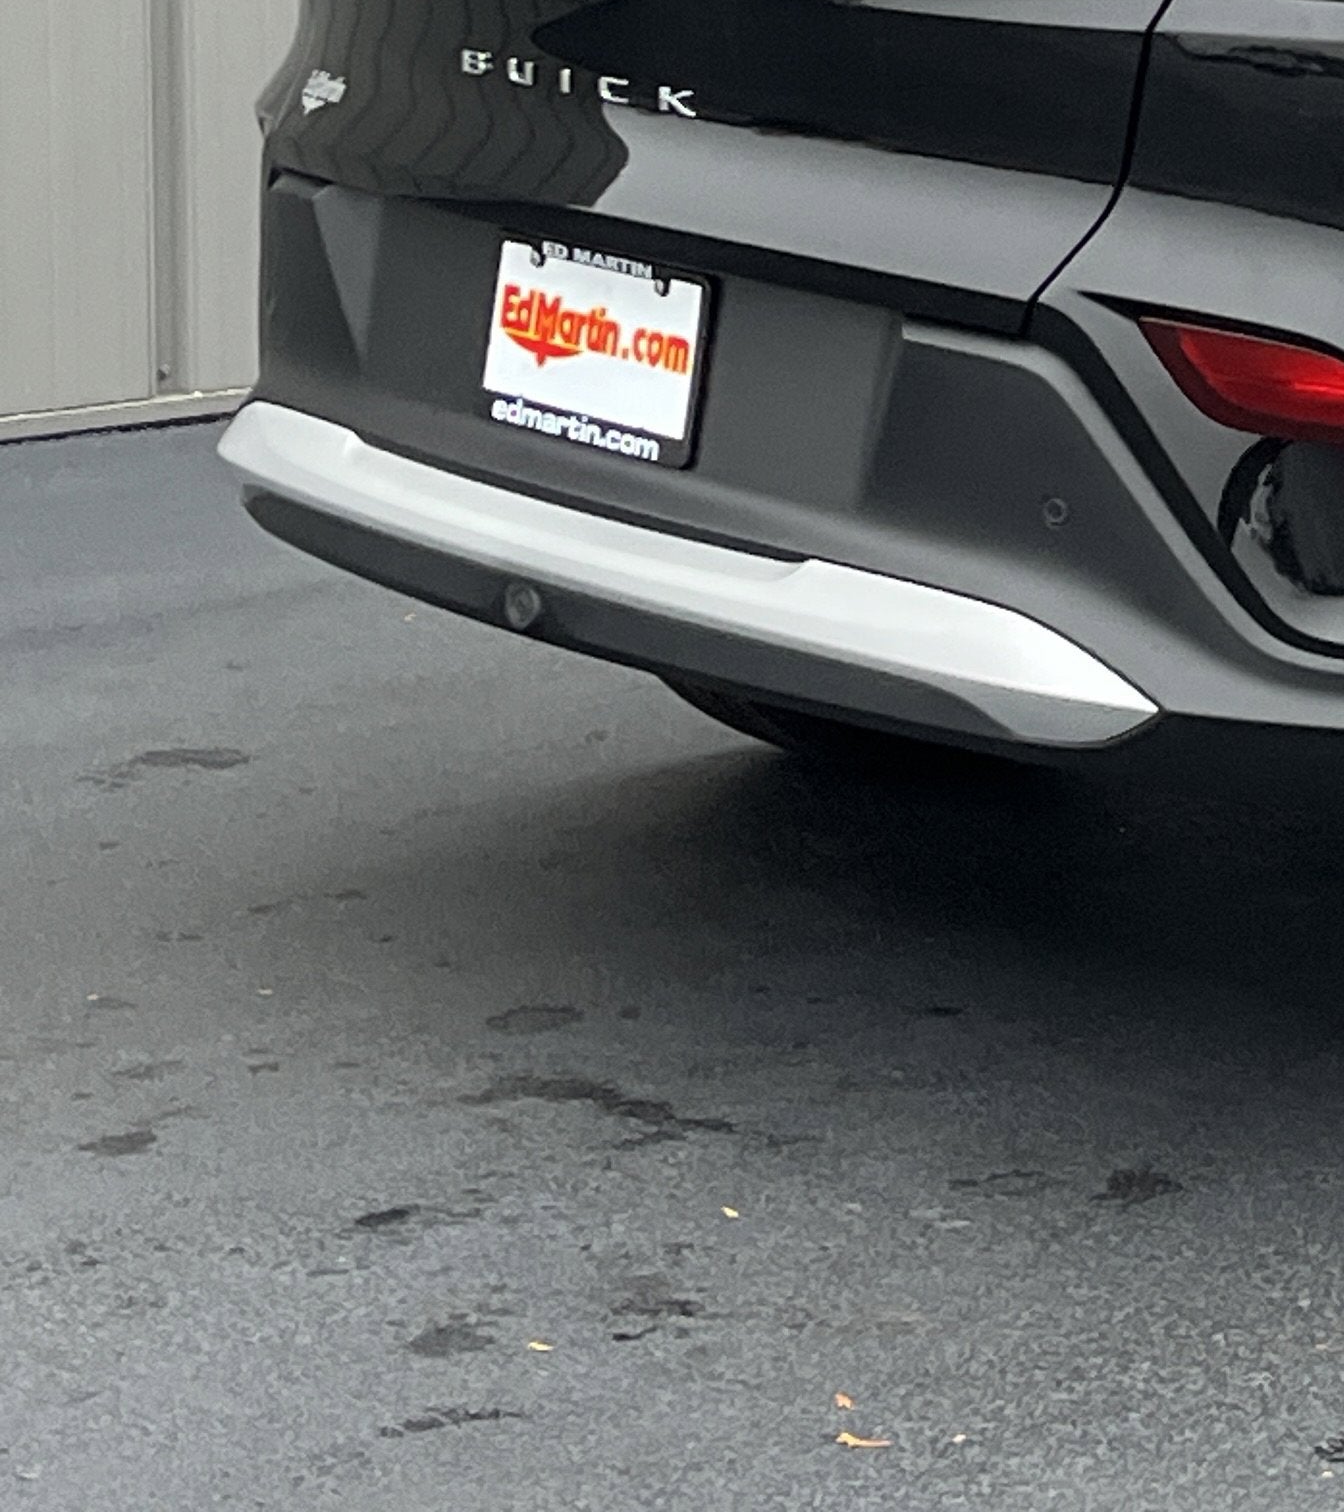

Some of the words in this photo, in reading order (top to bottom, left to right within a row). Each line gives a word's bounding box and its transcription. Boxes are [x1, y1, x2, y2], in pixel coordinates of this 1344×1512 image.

[461, 48, 697, 118] BUICK
[542, 241, 568, 260] ED
[573, 247, 653, 279] MARTIN
[501, 284, 689, 375] EdMartin.com
[491, 398, 660, 462] edmartin.com
